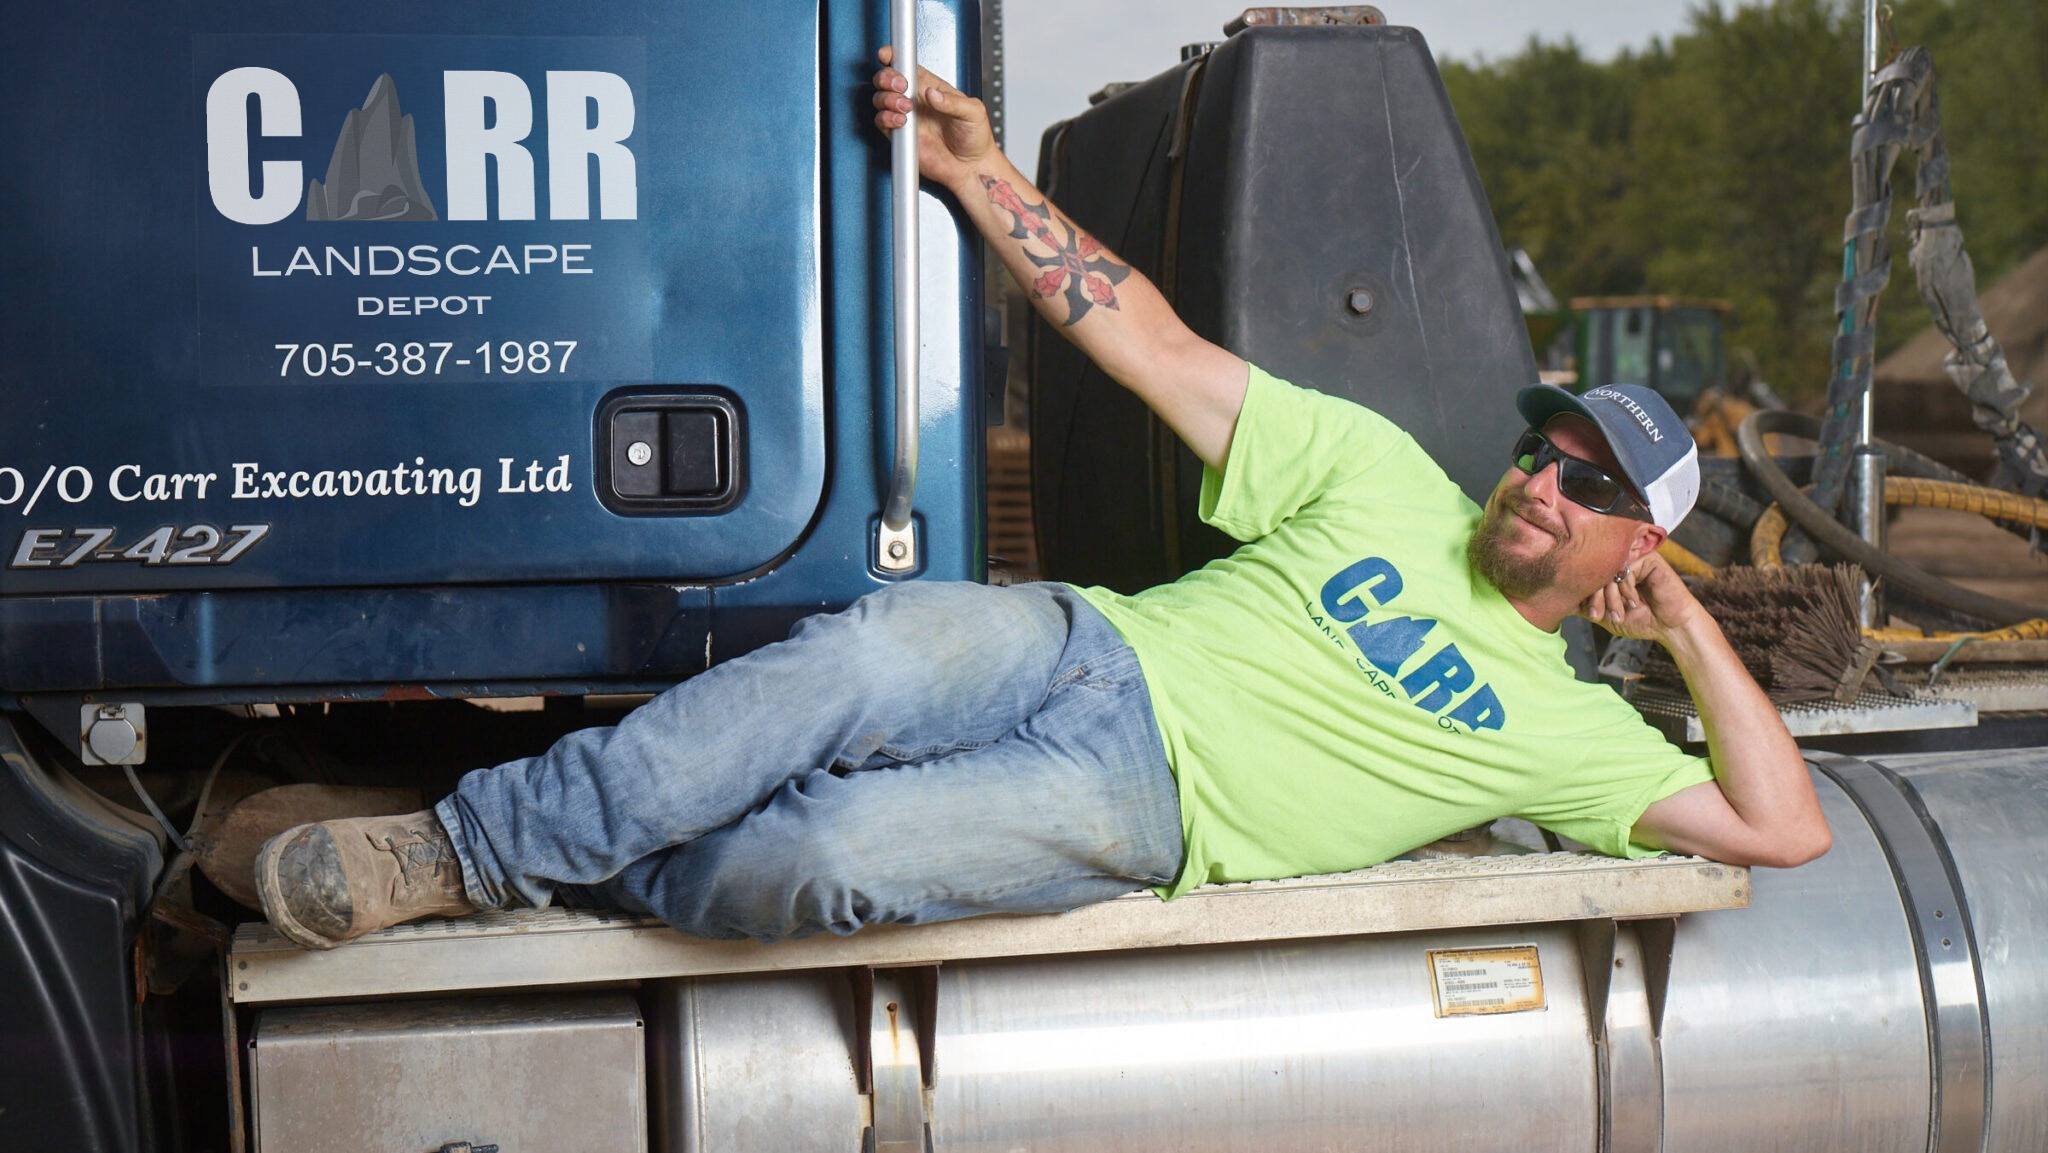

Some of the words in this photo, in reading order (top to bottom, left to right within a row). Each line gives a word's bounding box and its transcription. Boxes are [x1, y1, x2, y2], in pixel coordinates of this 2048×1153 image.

[252, 244, 594, 277] LANDSCAPE
[357, 296, 492, 316] DEPOT
[275, 340, 578, 377] 705-387-1987
[1590, 388, 1664, 442] NORTHERN
[108, 464, 217, 502] Carr
[231, 456, 482, 507] Excavating
[498, 454, 573, 493] Ltd
[8, 522, 271, 569] E7-427
